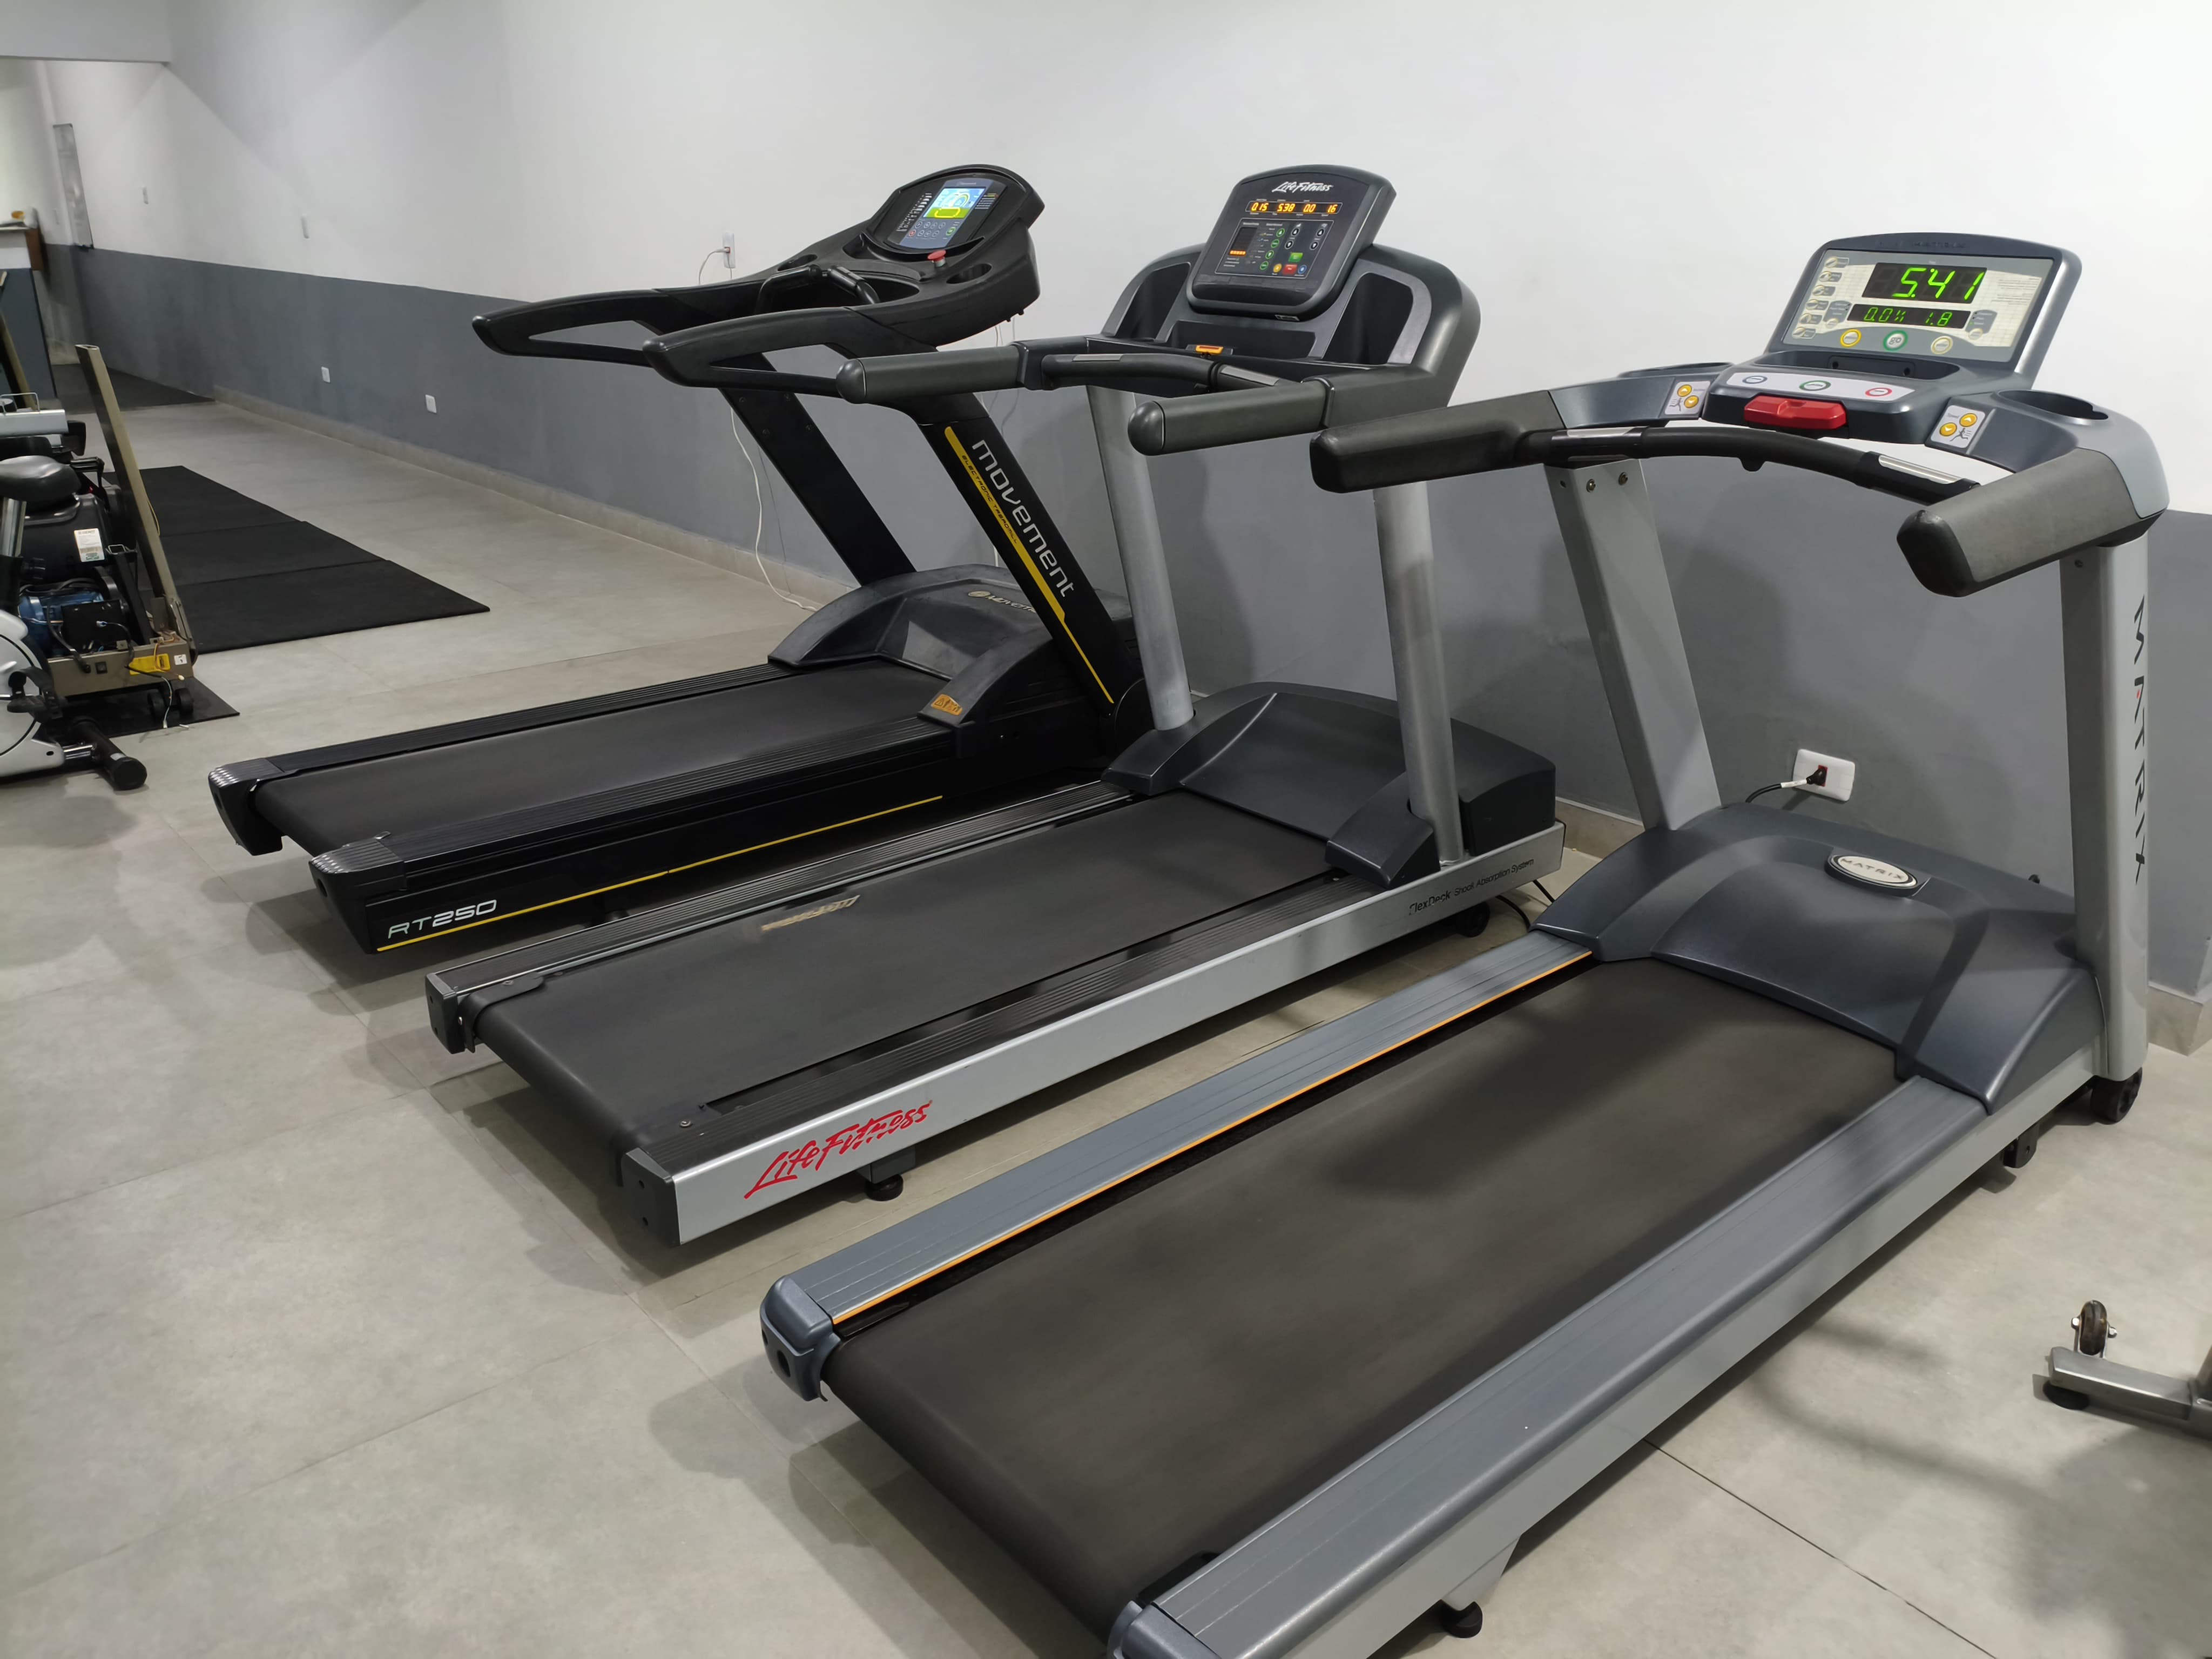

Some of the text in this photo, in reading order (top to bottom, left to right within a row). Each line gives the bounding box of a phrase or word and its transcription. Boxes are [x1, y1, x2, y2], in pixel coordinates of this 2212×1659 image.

[1889, 337, 1901, 345] go
[972, 439, 1074, 598] movement
[2134, 593, 2146, 886] MATRIX
[1453, 881, 1475, 896] Shock
[1475, 867, 1511, 888] Absorption
[1510, 858, 1534, 873] System
[1839, 857, 1904, 880] MATRIX
[387, 899, 497, 939] RT250
